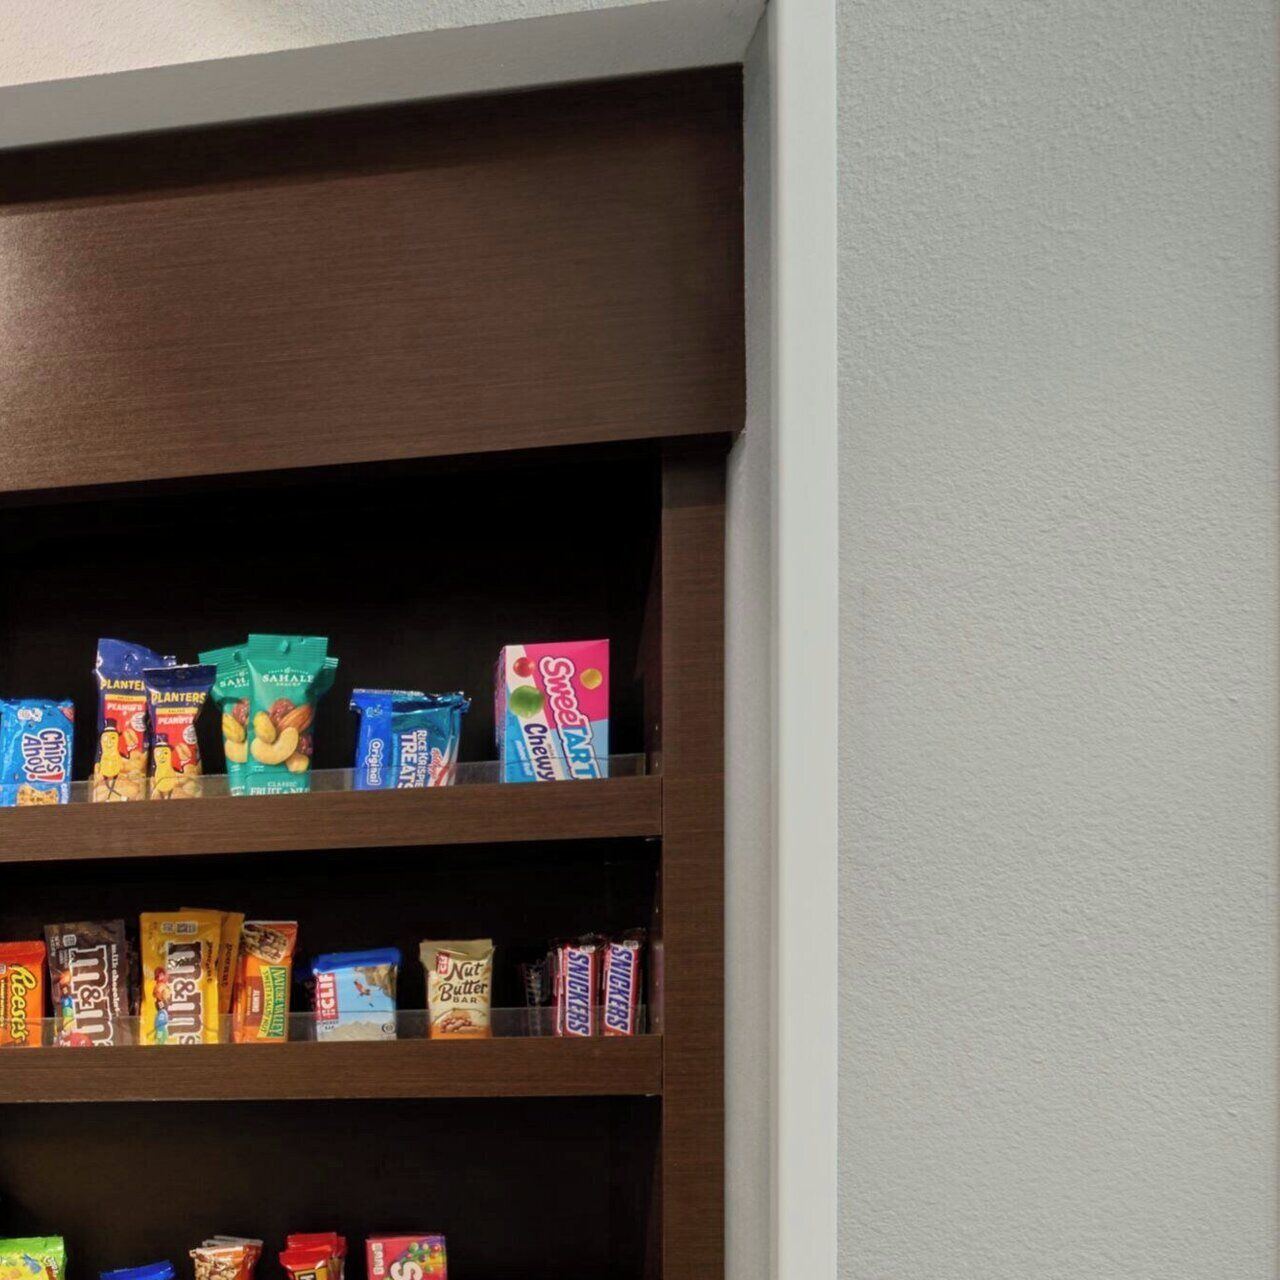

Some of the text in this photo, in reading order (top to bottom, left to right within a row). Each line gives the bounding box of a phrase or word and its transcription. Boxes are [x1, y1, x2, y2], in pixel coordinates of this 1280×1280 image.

[152, 692, 206, 704] PLANTERS
[263, 674, 313, 683] SAHALE
[539, 655, 602, 779] SweeTART
[40, 731, 64, 777] Chips
[368, 740, 382, 784] Original
[399, 731, 418, 788] TREATS
[525, 723, 555, 780] Chewy
[440, 979, 488, 1002] Butter
[445, 961, 484, 981] Nut
[568, 951, 590, 1035] SNICKERS
[607, 944, 632, 1033] SNICKERS
[10, 965, 37, 1041] Reese's
[270, 967, 287, 1036] NATURE VALLEY
